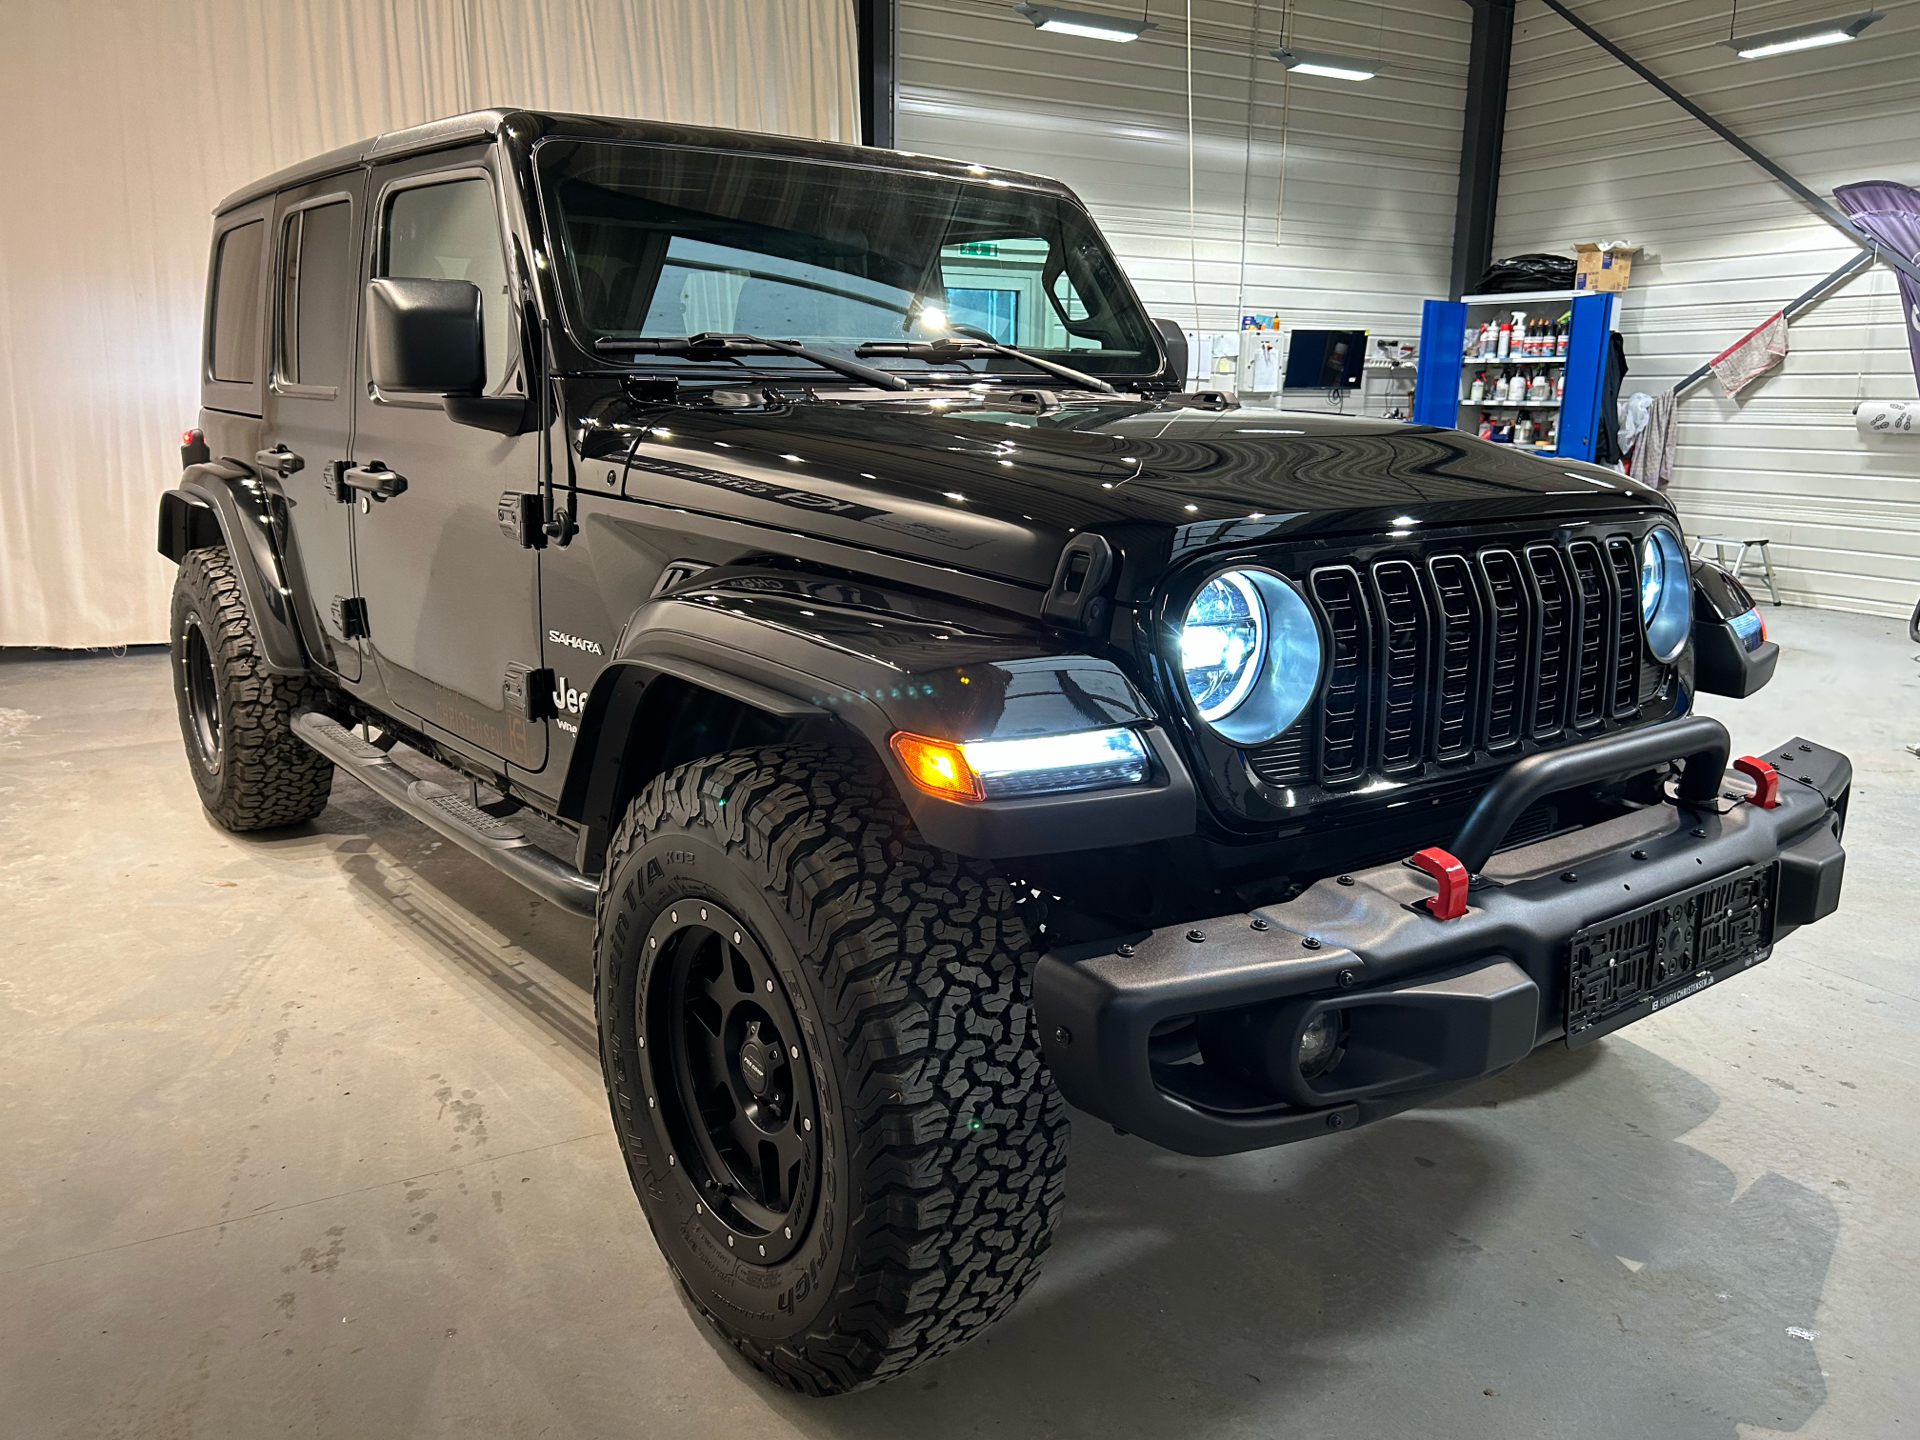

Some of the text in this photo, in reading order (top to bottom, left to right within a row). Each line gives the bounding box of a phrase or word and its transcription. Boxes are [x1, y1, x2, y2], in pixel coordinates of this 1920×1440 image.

[549, 630, 602, 656] SAHARA
[552, 677, 588, 714] Jee
[622, 856, 665, 912] T/A
[665, 851, 695, 866] KO2
